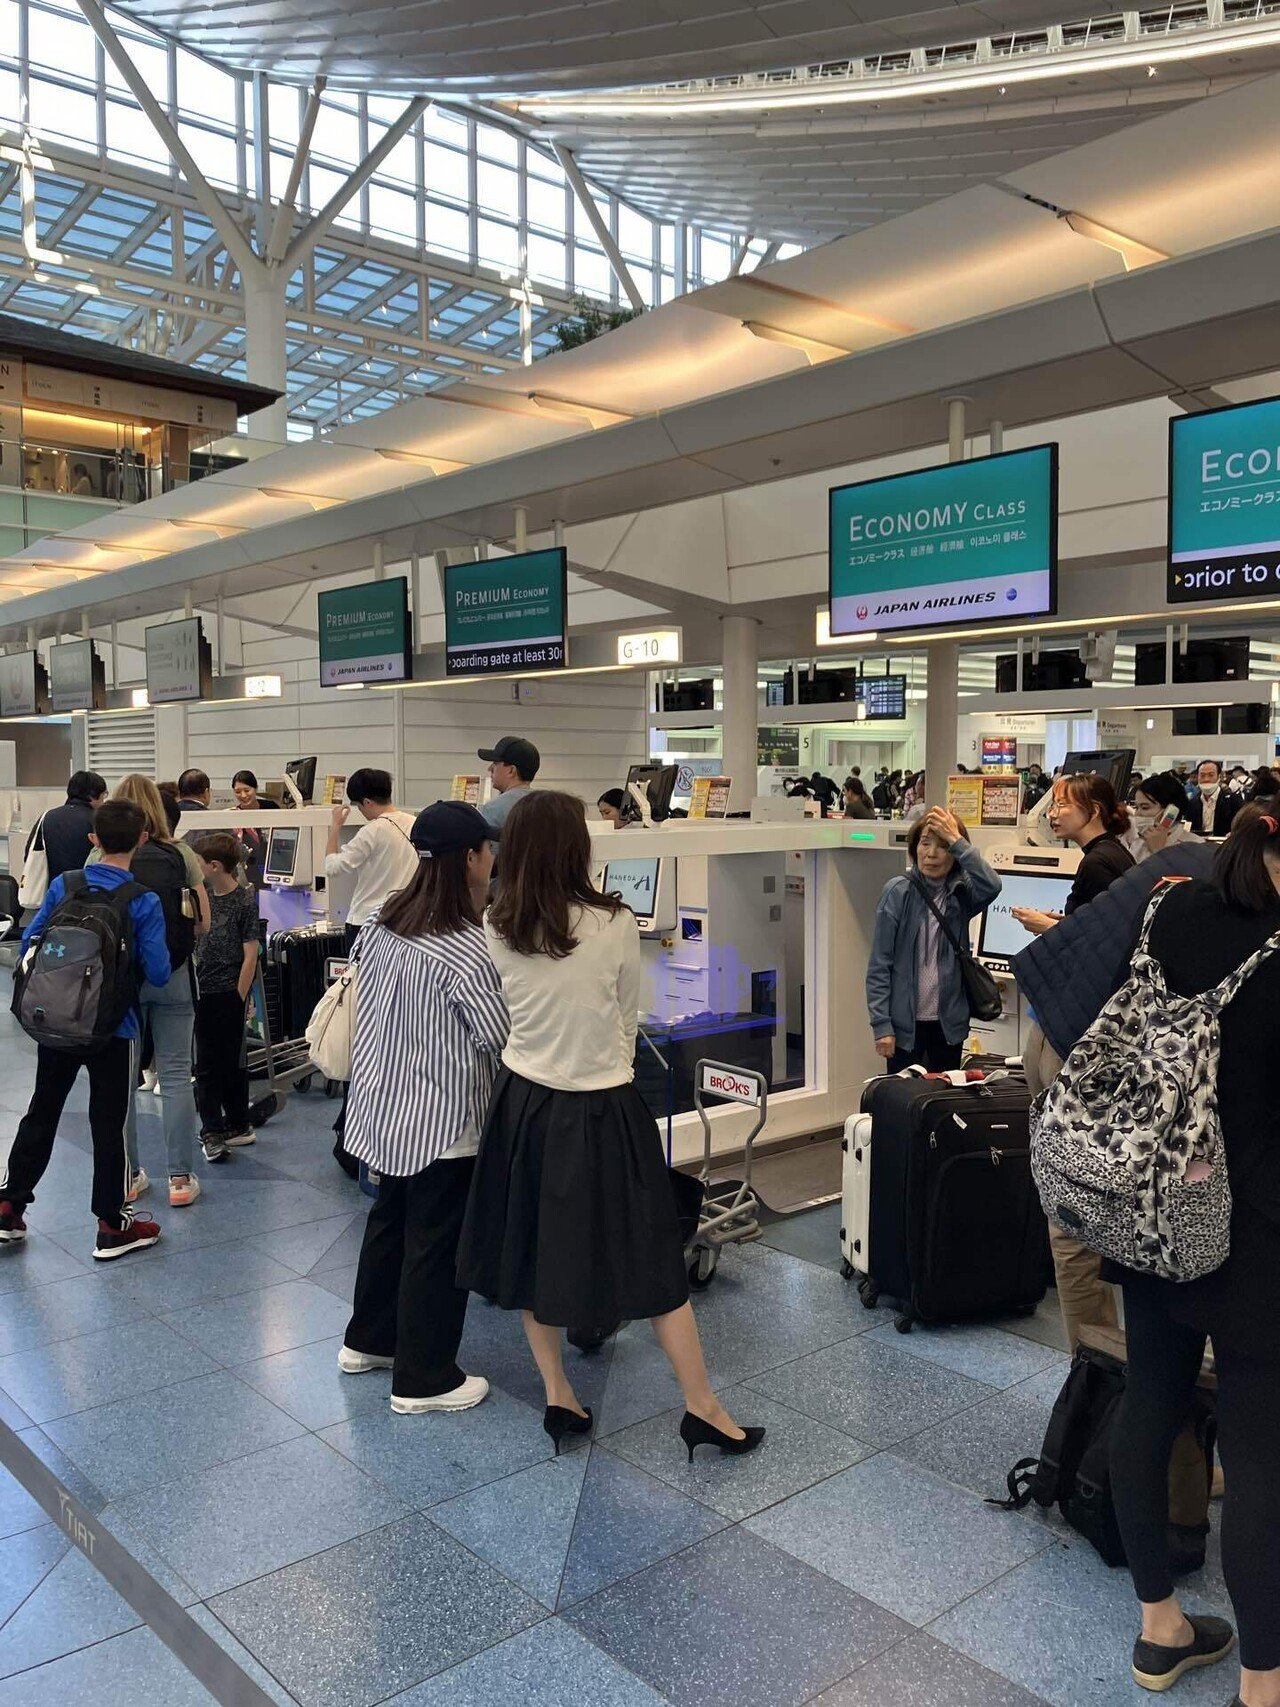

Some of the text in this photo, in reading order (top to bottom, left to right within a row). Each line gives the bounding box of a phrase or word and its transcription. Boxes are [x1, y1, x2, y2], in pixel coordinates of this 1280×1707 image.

[1202, 446, 1280, 483] ECO
[850, 500, 1026, 542] ECONOMY CLASS
[1242, 563, 1268, 583] to
[456, 586, 549, 607] PREMIUM ECONOMY
[873, 591, 996, 616] JAPAN AIRLINES
[326, 611, 366, 628] PREMIUM
[490, 653, 511, 666] gate
[512, 651, 522, 663] at
[524, 649, 546, 662] least
[623, 639, 659, 658] G-10
[803, 737, 810, 749] 5
[971, 740, 977, 751] 3
[609, 874, 636, 882] HANEDA
